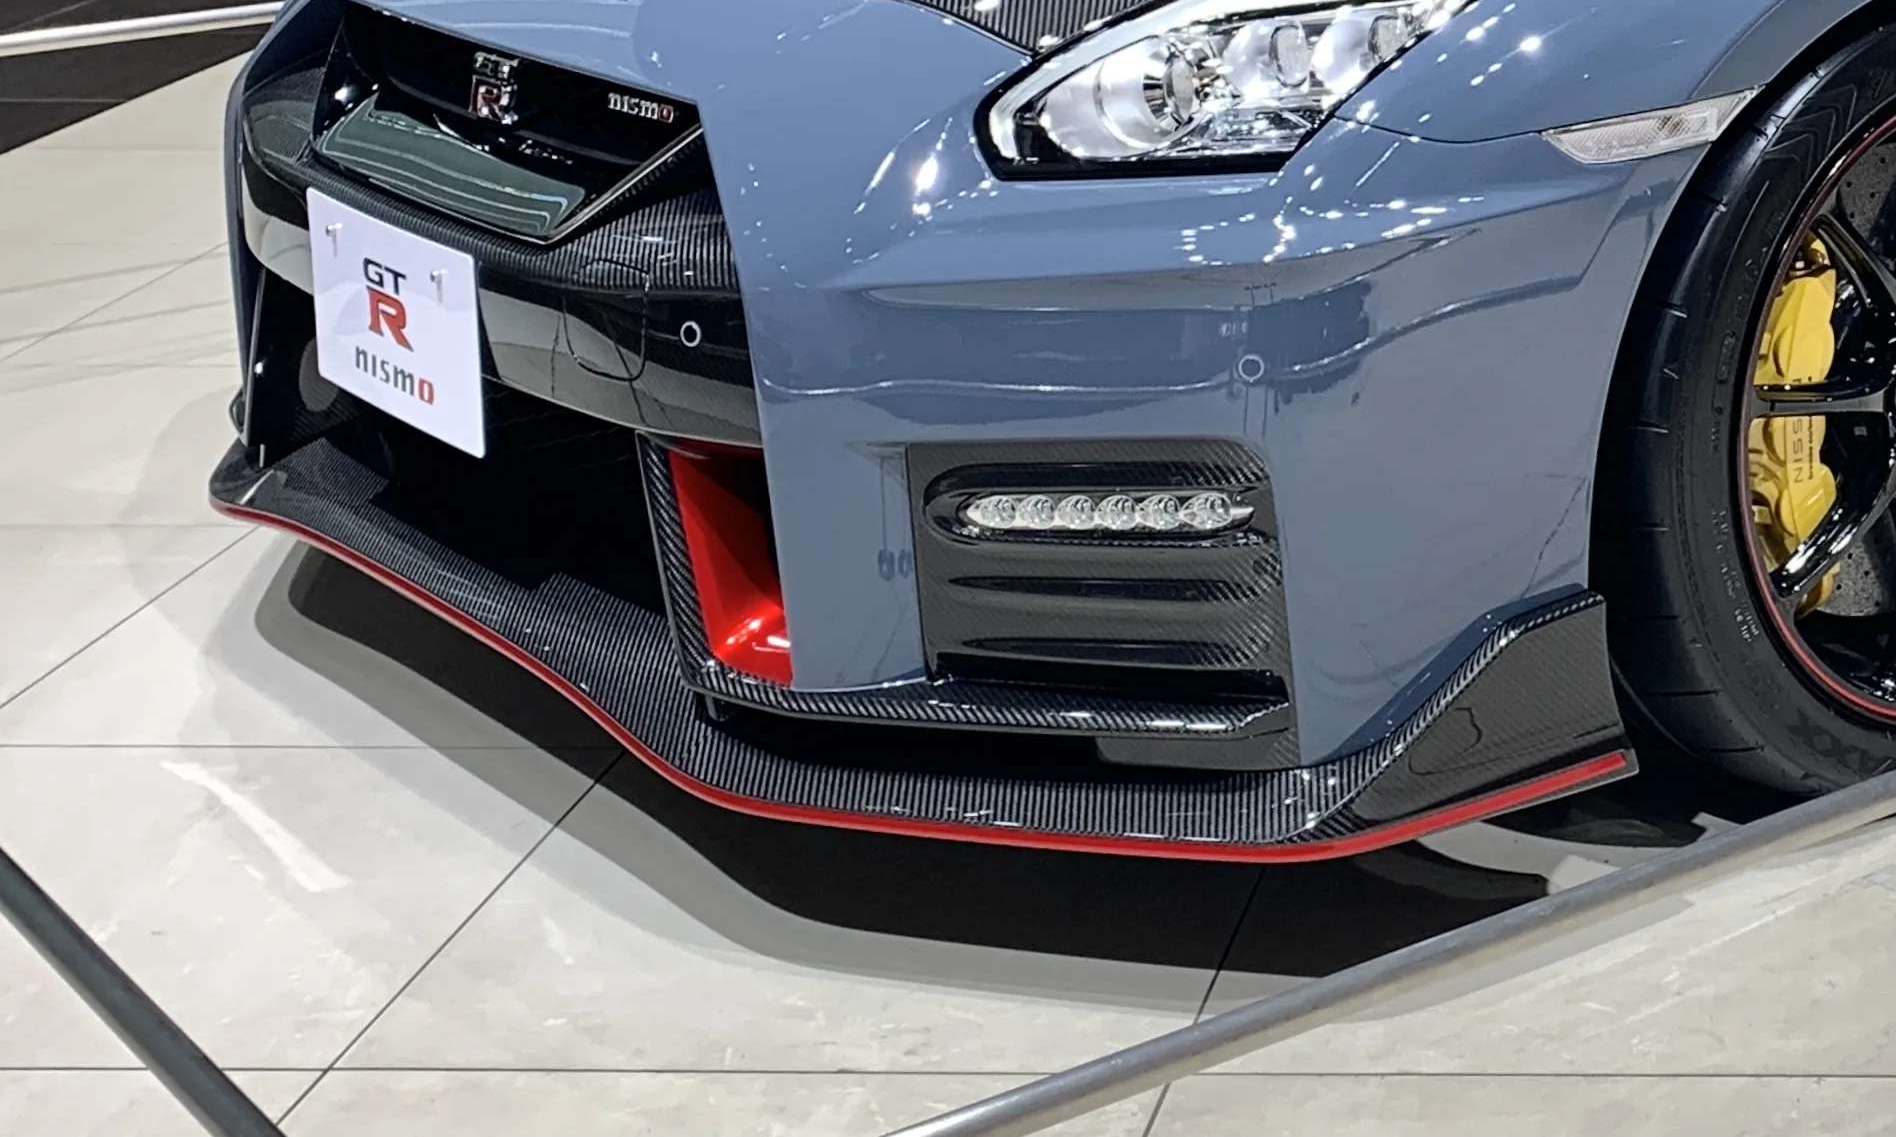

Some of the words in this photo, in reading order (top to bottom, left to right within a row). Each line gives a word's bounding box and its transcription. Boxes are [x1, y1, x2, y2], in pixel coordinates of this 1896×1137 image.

[608, 92, 674, 123] nismo
[363, 257, 407, 296] GT
[366, 285, 414, 352] R
[355, 345, 434, 406] nismo
